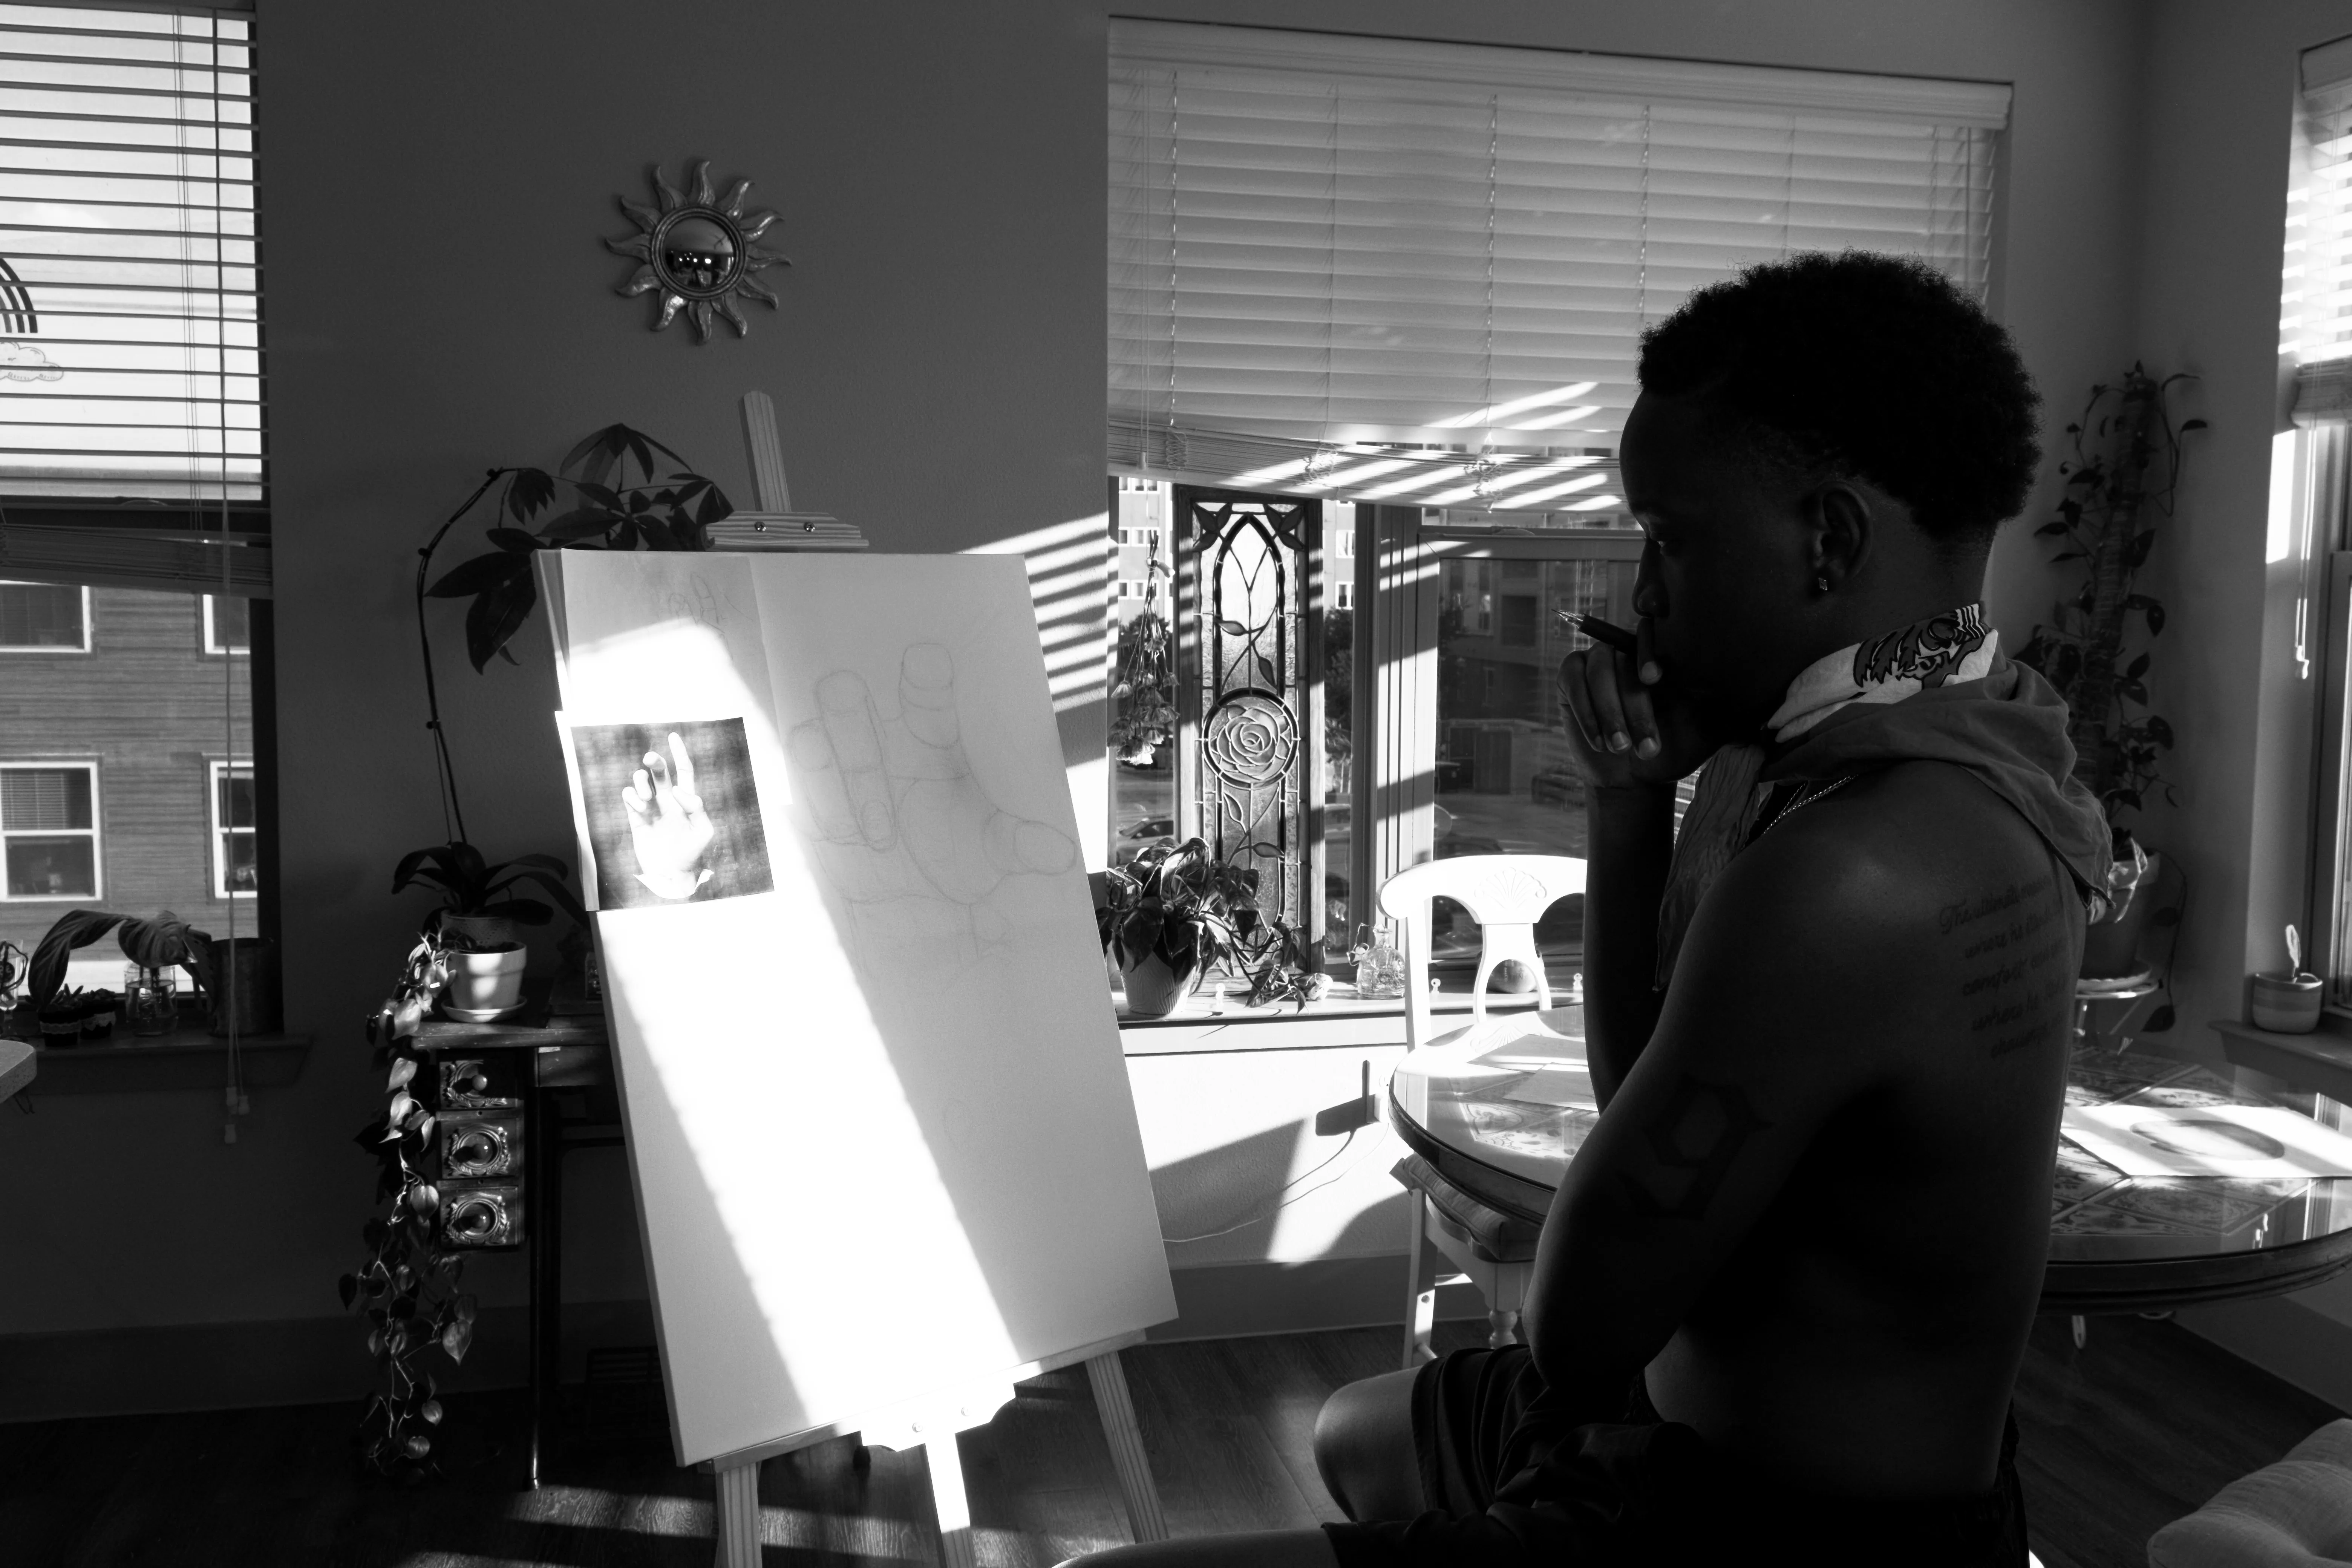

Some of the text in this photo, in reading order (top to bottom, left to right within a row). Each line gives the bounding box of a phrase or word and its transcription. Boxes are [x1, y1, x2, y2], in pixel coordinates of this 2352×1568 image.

[1939, 899, 1972, 934] The
[1961, 957, 2028, 996] comfort
[1616, 1072, 1776, 1220] 9
